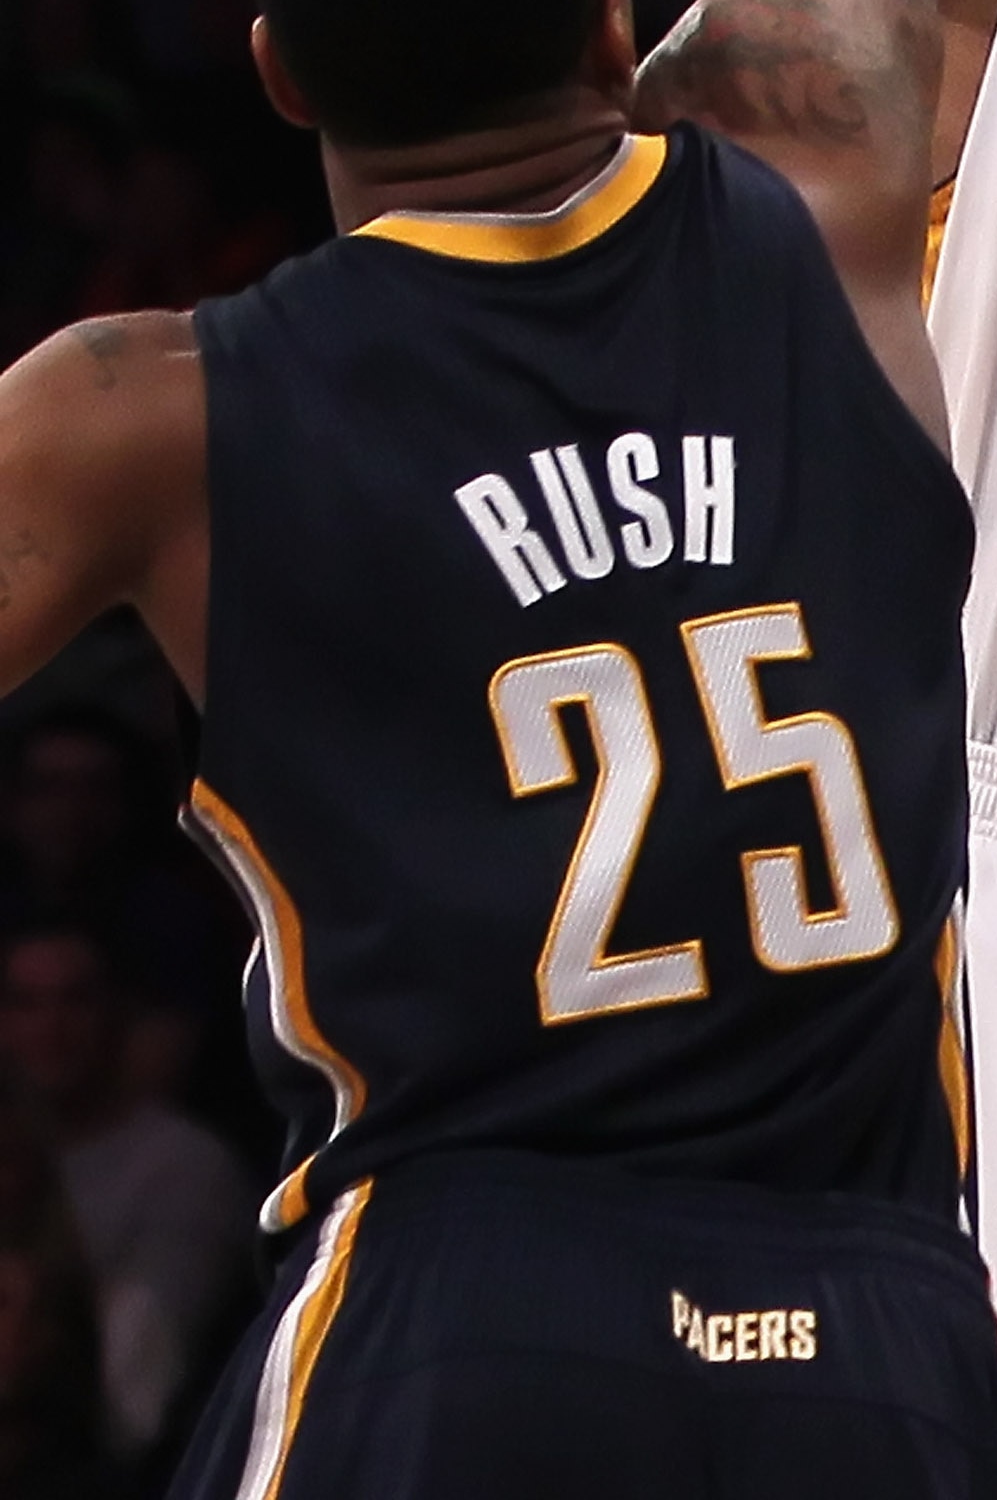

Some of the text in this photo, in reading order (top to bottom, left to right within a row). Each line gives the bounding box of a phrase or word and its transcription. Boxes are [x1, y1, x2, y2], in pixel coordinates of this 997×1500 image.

[453, 432, 735, 608] RUSH
[488, 601, 900, 1027] 25
[670, 1288, 818, 1363] PACERS
